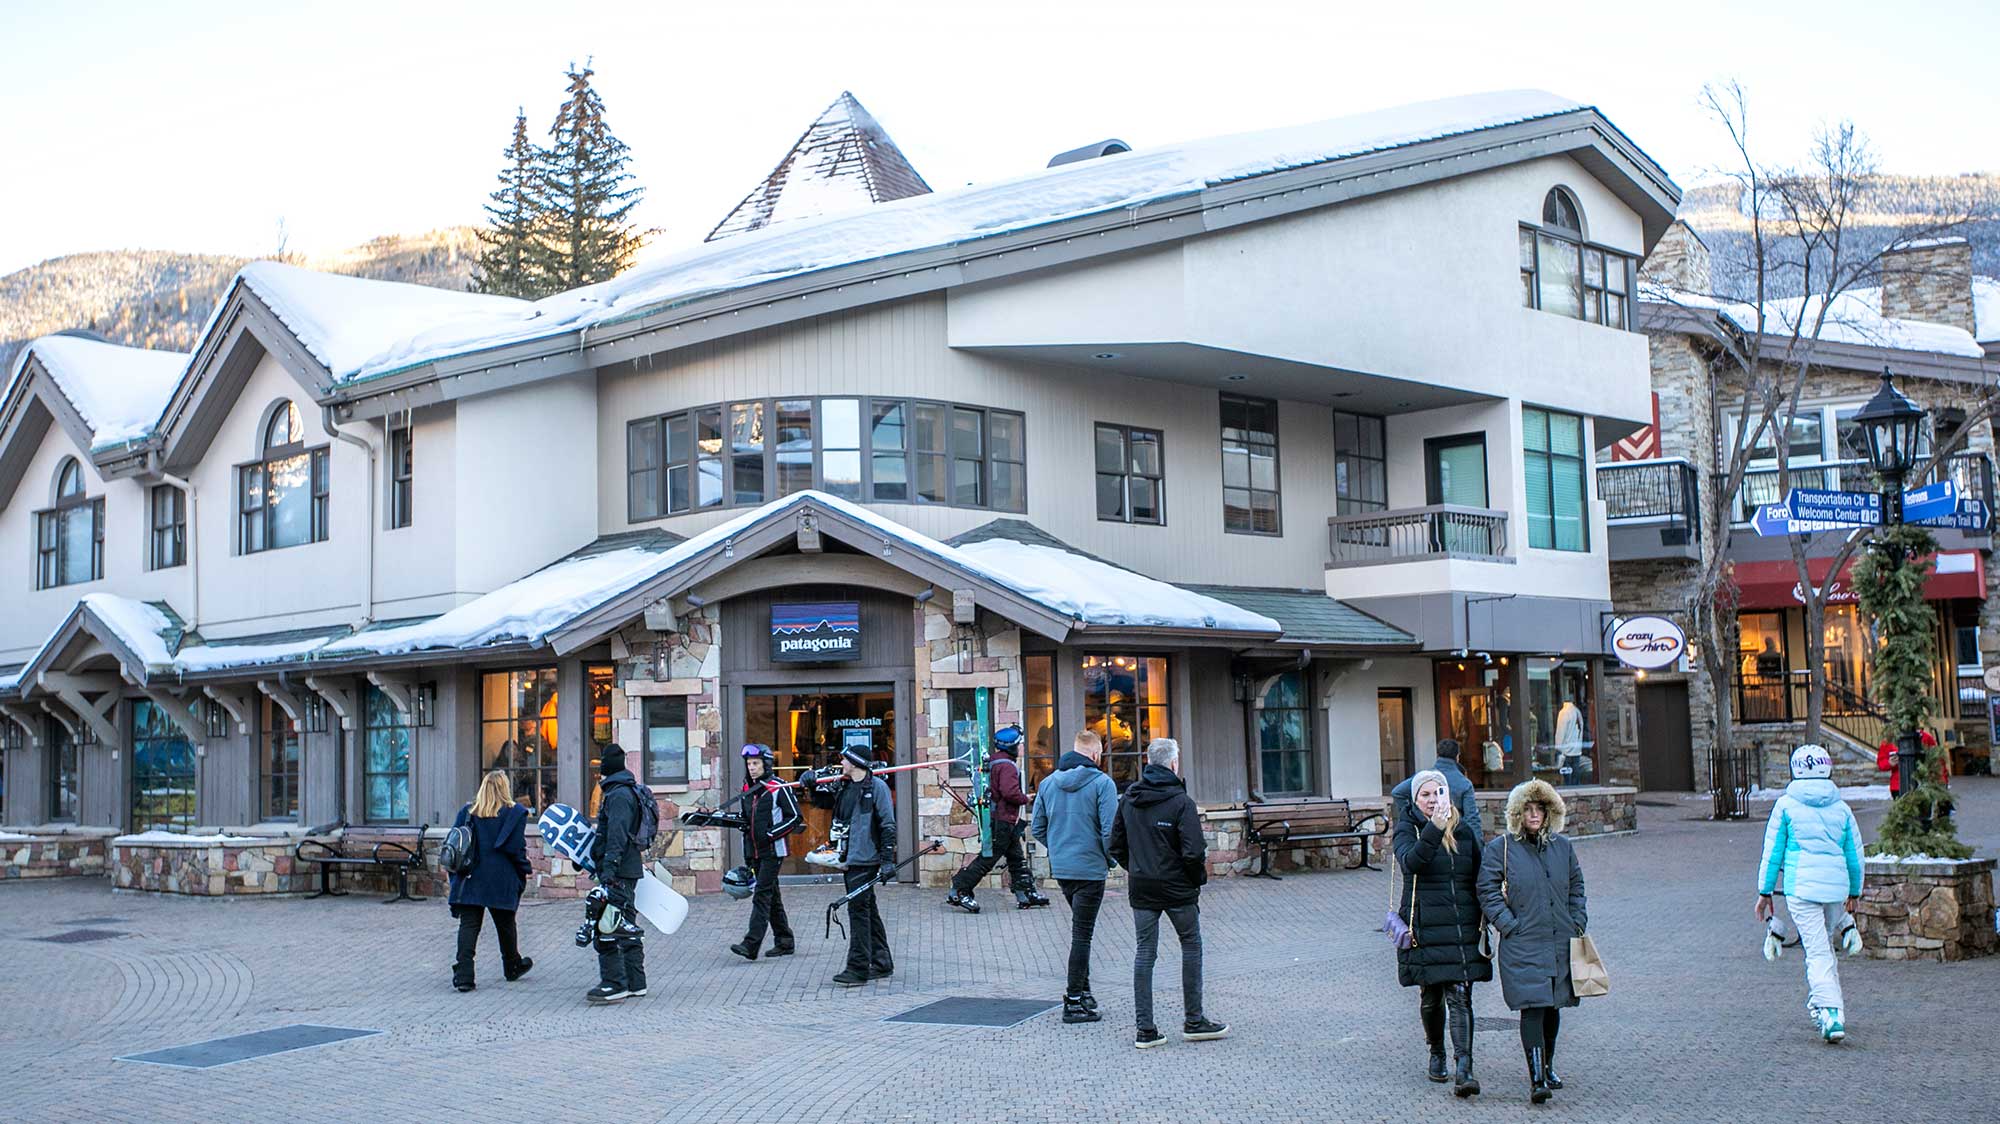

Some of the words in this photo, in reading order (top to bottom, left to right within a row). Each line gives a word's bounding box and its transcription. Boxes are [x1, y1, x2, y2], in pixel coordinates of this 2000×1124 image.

[1797, 491, 1852, 506] Transportation
[1853, 494, 1865, 506] Ctr
[1798, 506, 1833, 519] Welcome
[1834, 509, 1860, 521] Center
[1957, 515, 1971, 526] Trail
[1626, 633, 1654, 642] crazy
[781, 637, 852, 652] patagonia
[833, 717, 882, 728] patagonia
